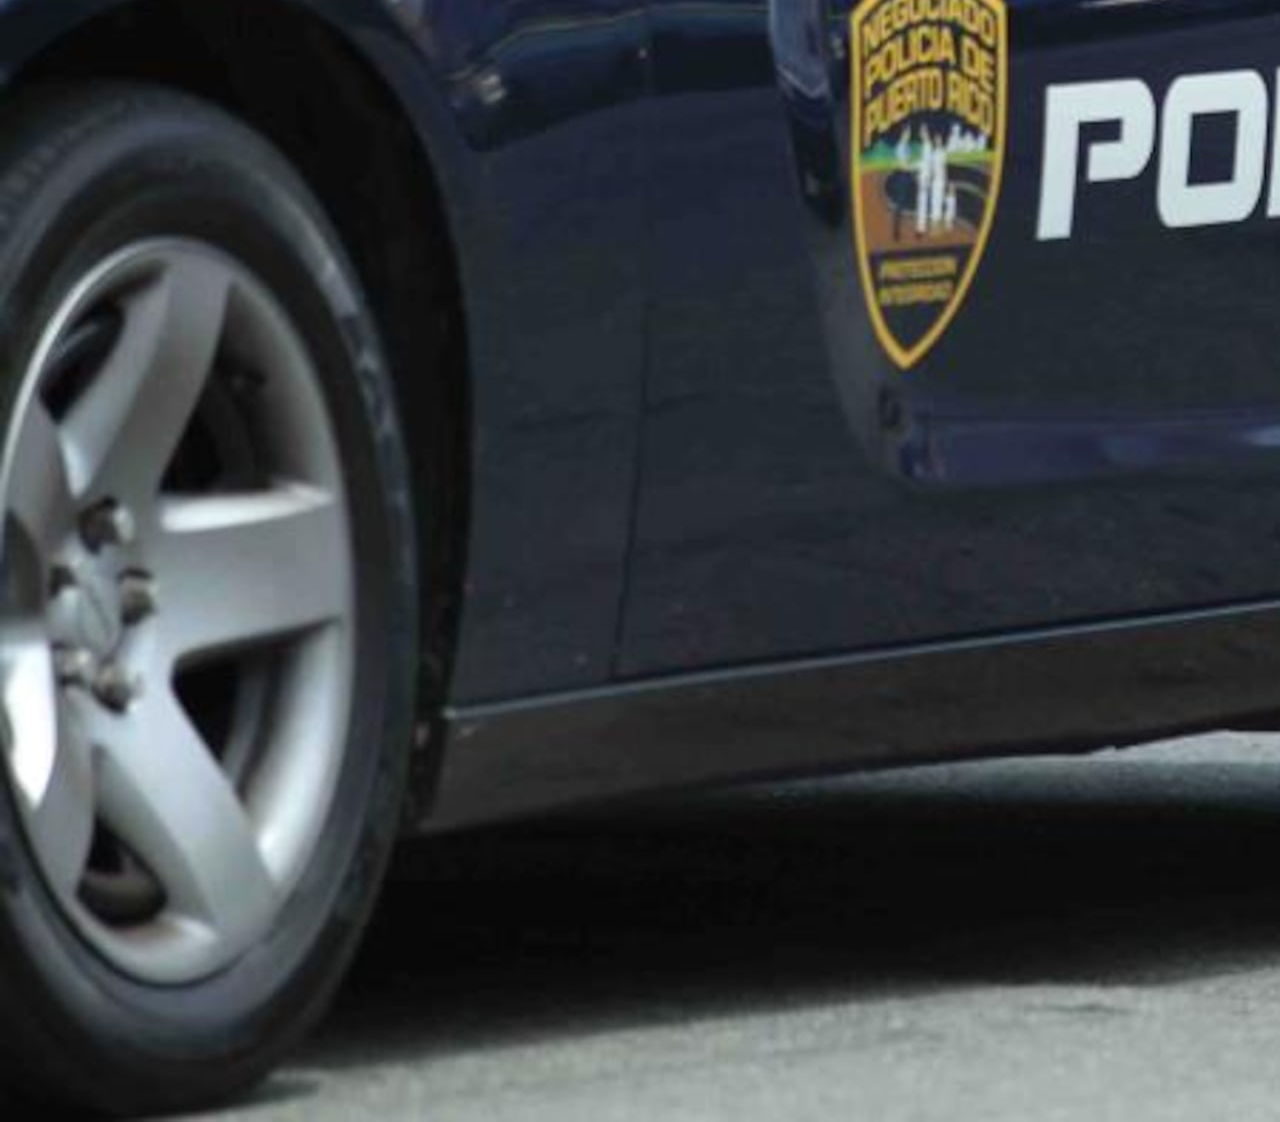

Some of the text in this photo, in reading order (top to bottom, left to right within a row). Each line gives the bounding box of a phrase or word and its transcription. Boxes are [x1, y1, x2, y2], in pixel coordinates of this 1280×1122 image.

[865, 27, 995, 99] POLICIA DE
[864, 67, 995, 150] PUERTO RICO
